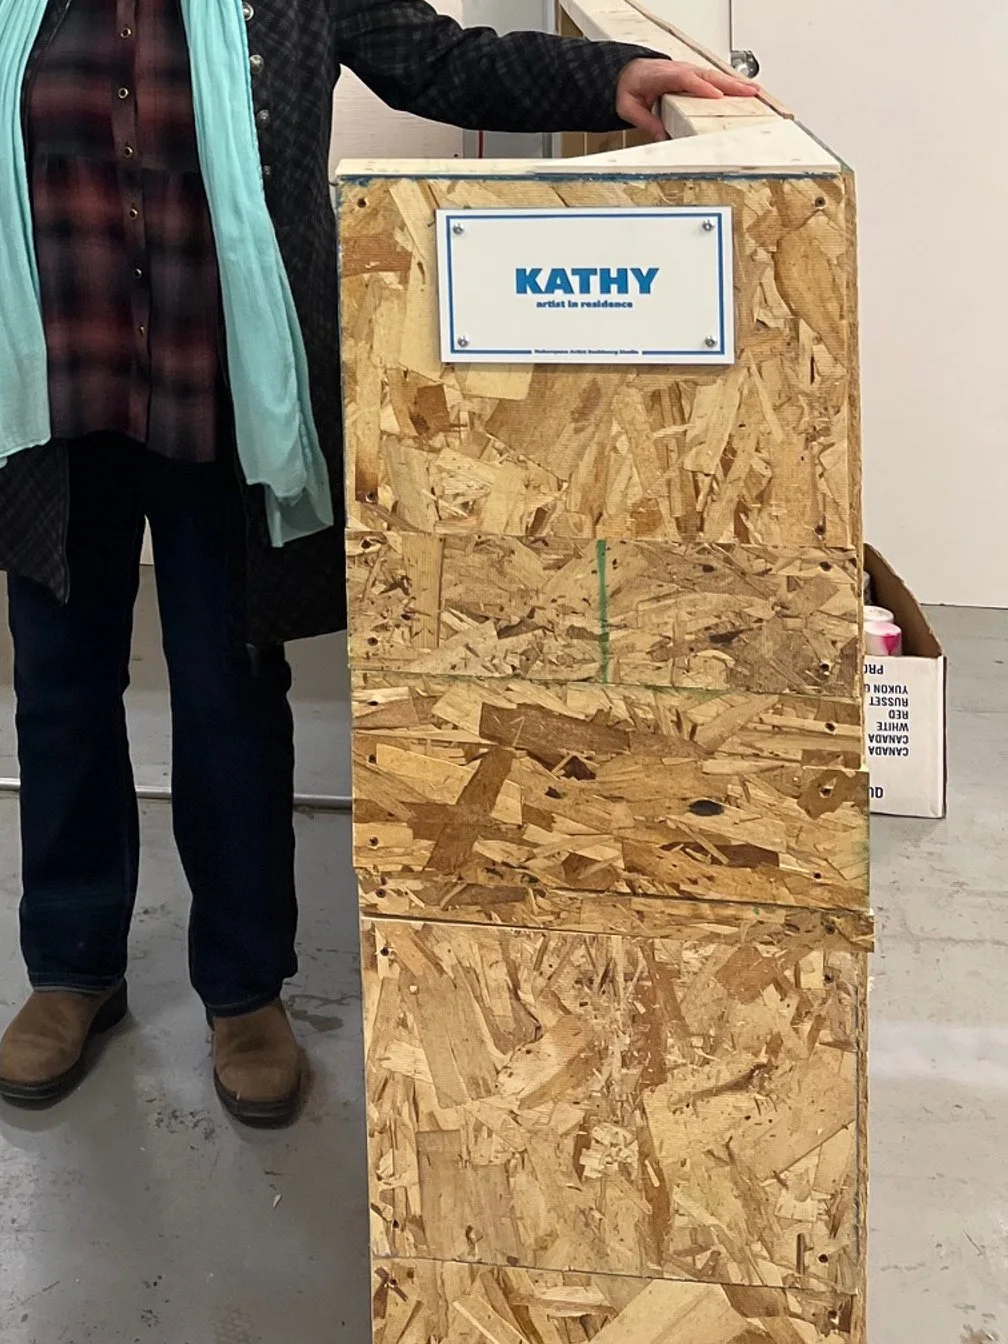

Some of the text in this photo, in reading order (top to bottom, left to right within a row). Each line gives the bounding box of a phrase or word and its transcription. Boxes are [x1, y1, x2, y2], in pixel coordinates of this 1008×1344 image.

[515, 268, 659, 294] KATHY
[536, 300, 633, 308] artist in residence
[873, 684, 908, 694] YUKON
[869, 697, 908, 706] RUSSET
[888, 710, 909, 719] RED
[877, 722, 909, 731] WHITE
[868, 734, 909, 744] CANADA
[868, 746, 909, 756] CANADA
